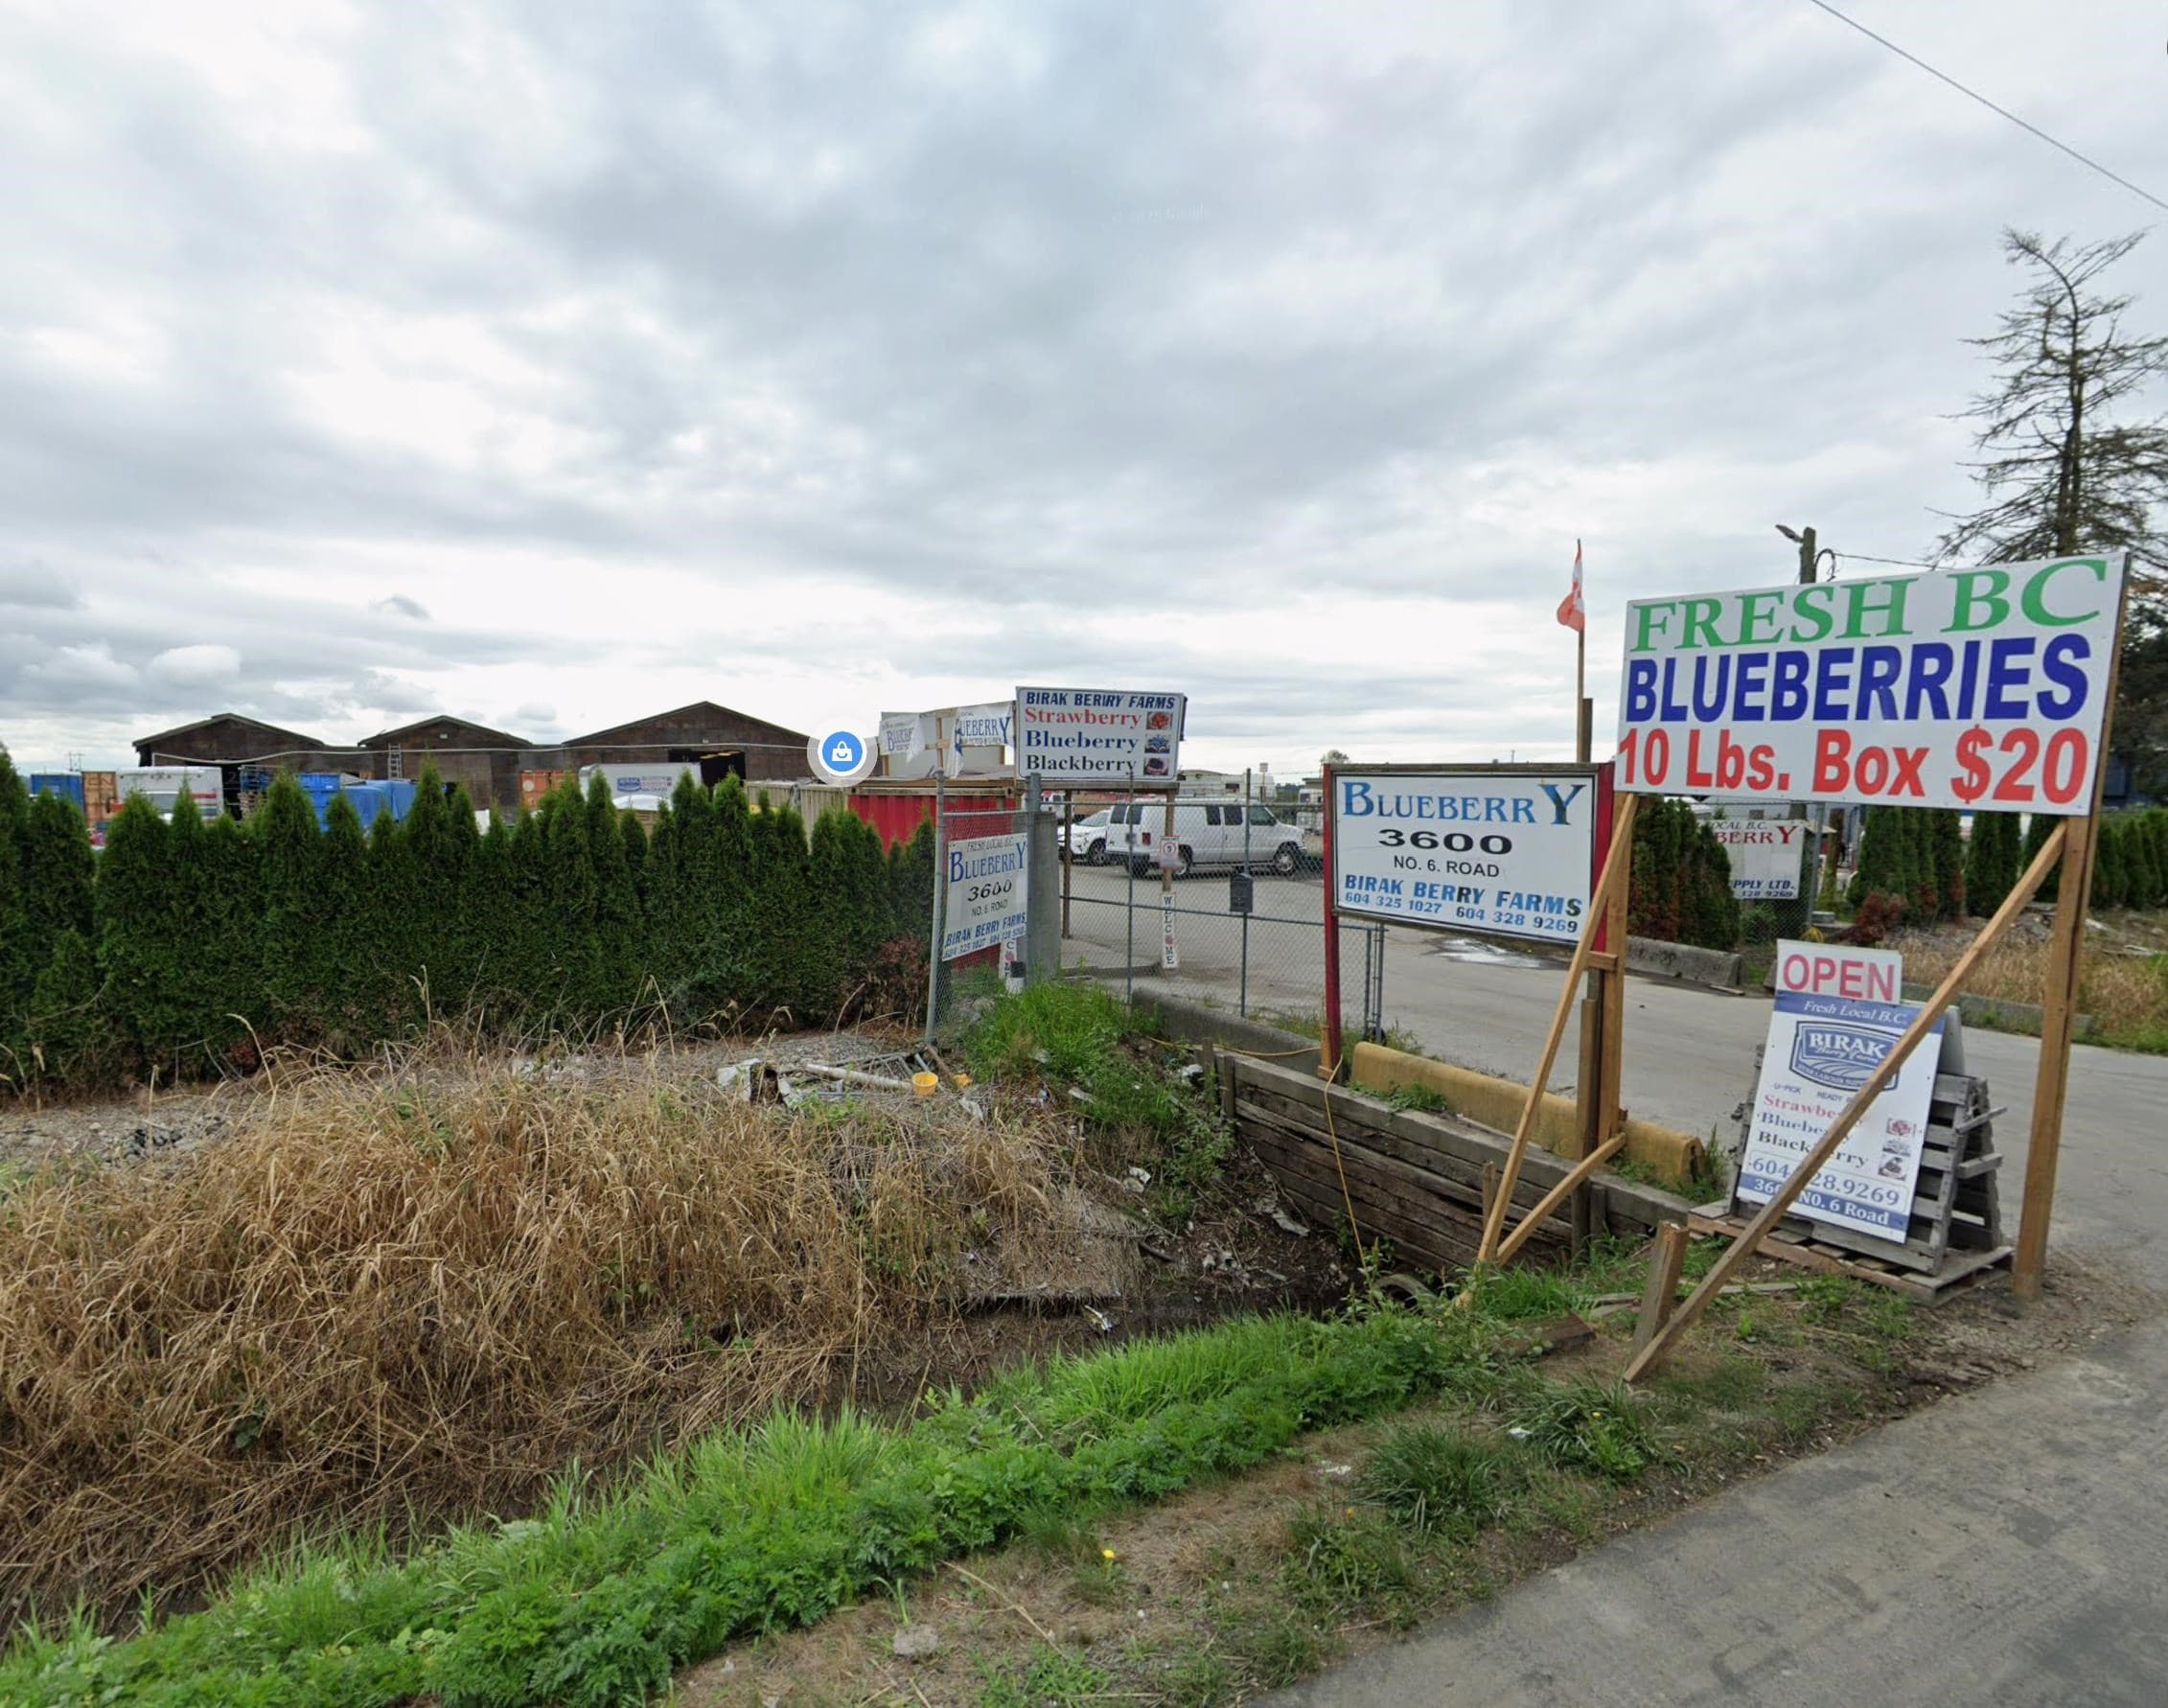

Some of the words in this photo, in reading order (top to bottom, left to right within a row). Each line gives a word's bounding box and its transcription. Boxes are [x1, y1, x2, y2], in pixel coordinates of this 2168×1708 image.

[1630, 578, 1919, 652] FRESH
[1940, 559, 2107, 633] BC
[1626, 634, 2090, 722] BLUEBERRIES
[1026, 692, 1068, 706] BIRAK
[1129, 696, 1176, 709] FARMS
[1026, 706, 1142, 729] Strawberry
[1026, 729, 1138, 753] Blueberry
[1027, 754, 1136, 775] Blackberry
[1619, 728, 1669, 785] 10
[1686, 728, 1790, 791] Lbs.
[1812, 728, 1929, 796] Box
[1949, 724, 2088, 803] $20
[1343, 781, 1586, 825] BLUEBERRY
[1712, 821, 1741, 830] OCAL
[1716, 826, 1797, 844] BERRY
[1378, 829, 1512, 855] 3600
[950, 842, 1026, 883] BLUEBERRY
[1394, 855, 1421, 871] NO.
[1446, 861, 1499, 878] ROAD
[967, 878, 1013, 902] 3600
[1345, 874, 1403, 895] BIRAK
[1414, 881, 1486, 905] BERRY
[1496, 890, 1582, 917] FARMS
[1733, 879, 1762, 889] PPLY
[1768, 879, 1795, 889] LTD.
[1345, 892, 1370, 906] 604
[1375, 895, 1402, 910] 325
[1409, 900, 1442, 913] 1027
[1456, 906, 1485, 920] 604
[1492, 912, 1525, 926] 328
[1534, 916, 1578, 934] 9269
[975, 919, 1000, 937] BERRY
[1164, 896, 1174, 964] WELCME
[1783, 954, 1895, 1002] OPEN
[1803, 1000, 1835, 1014] Fresh
[1839, 1005, 1876, 1020] Local
[1878, 1012, 1908, 1026] B.C.
[1808, 1032, 1886, 1059] BIRAK
[1759, 1131, 1869, 1168] Blackrry
[1753, 1158, 1900, 1206] 60428.9269
[1830, 1198, 1840, 1212] 6
[1845, 1202, 1889, 1225] Road
